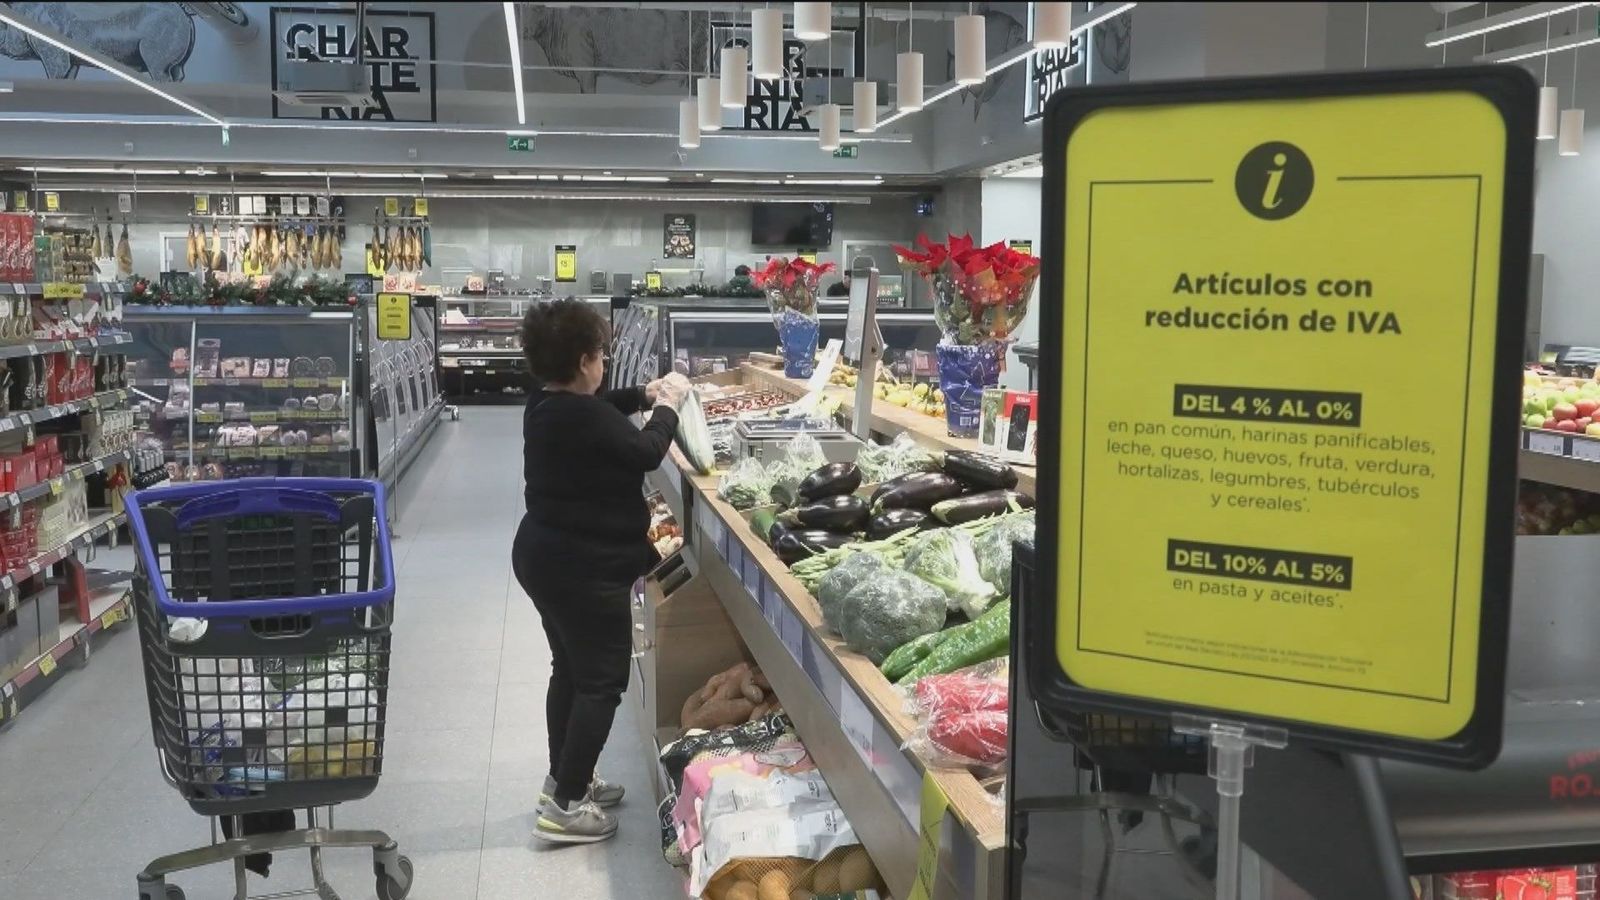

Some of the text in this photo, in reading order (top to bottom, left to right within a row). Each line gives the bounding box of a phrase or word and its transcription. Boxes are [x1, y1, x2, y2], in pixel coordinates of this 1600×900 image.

[286, 23, 410, 58] CHAR
[744, 99, 811, 130] RIA
[1173, 272, 1373, 298] Artículos con
[1145, 306, 1402, 335] reducción de IVA
[1182, 393, 1353, 421] DEL 4 % AL 0%
[1108, 420, 1435, 455] en pan común, harinas panificables,
[1107, 439, 1435, 478] leche, queso, huevos, fruta, verdura,
[1118, 461, 1420, 499] hortalizas, legumbres, tubérculos
[1211, 493, 1222, 508] y
[1174, 549, 1345, 583] DEL 10% AL 5%
[1172, 578, 1193, 591] en
[1199, 582, 1248, 598] pasta
[1253, 588, 1265, 601] y
